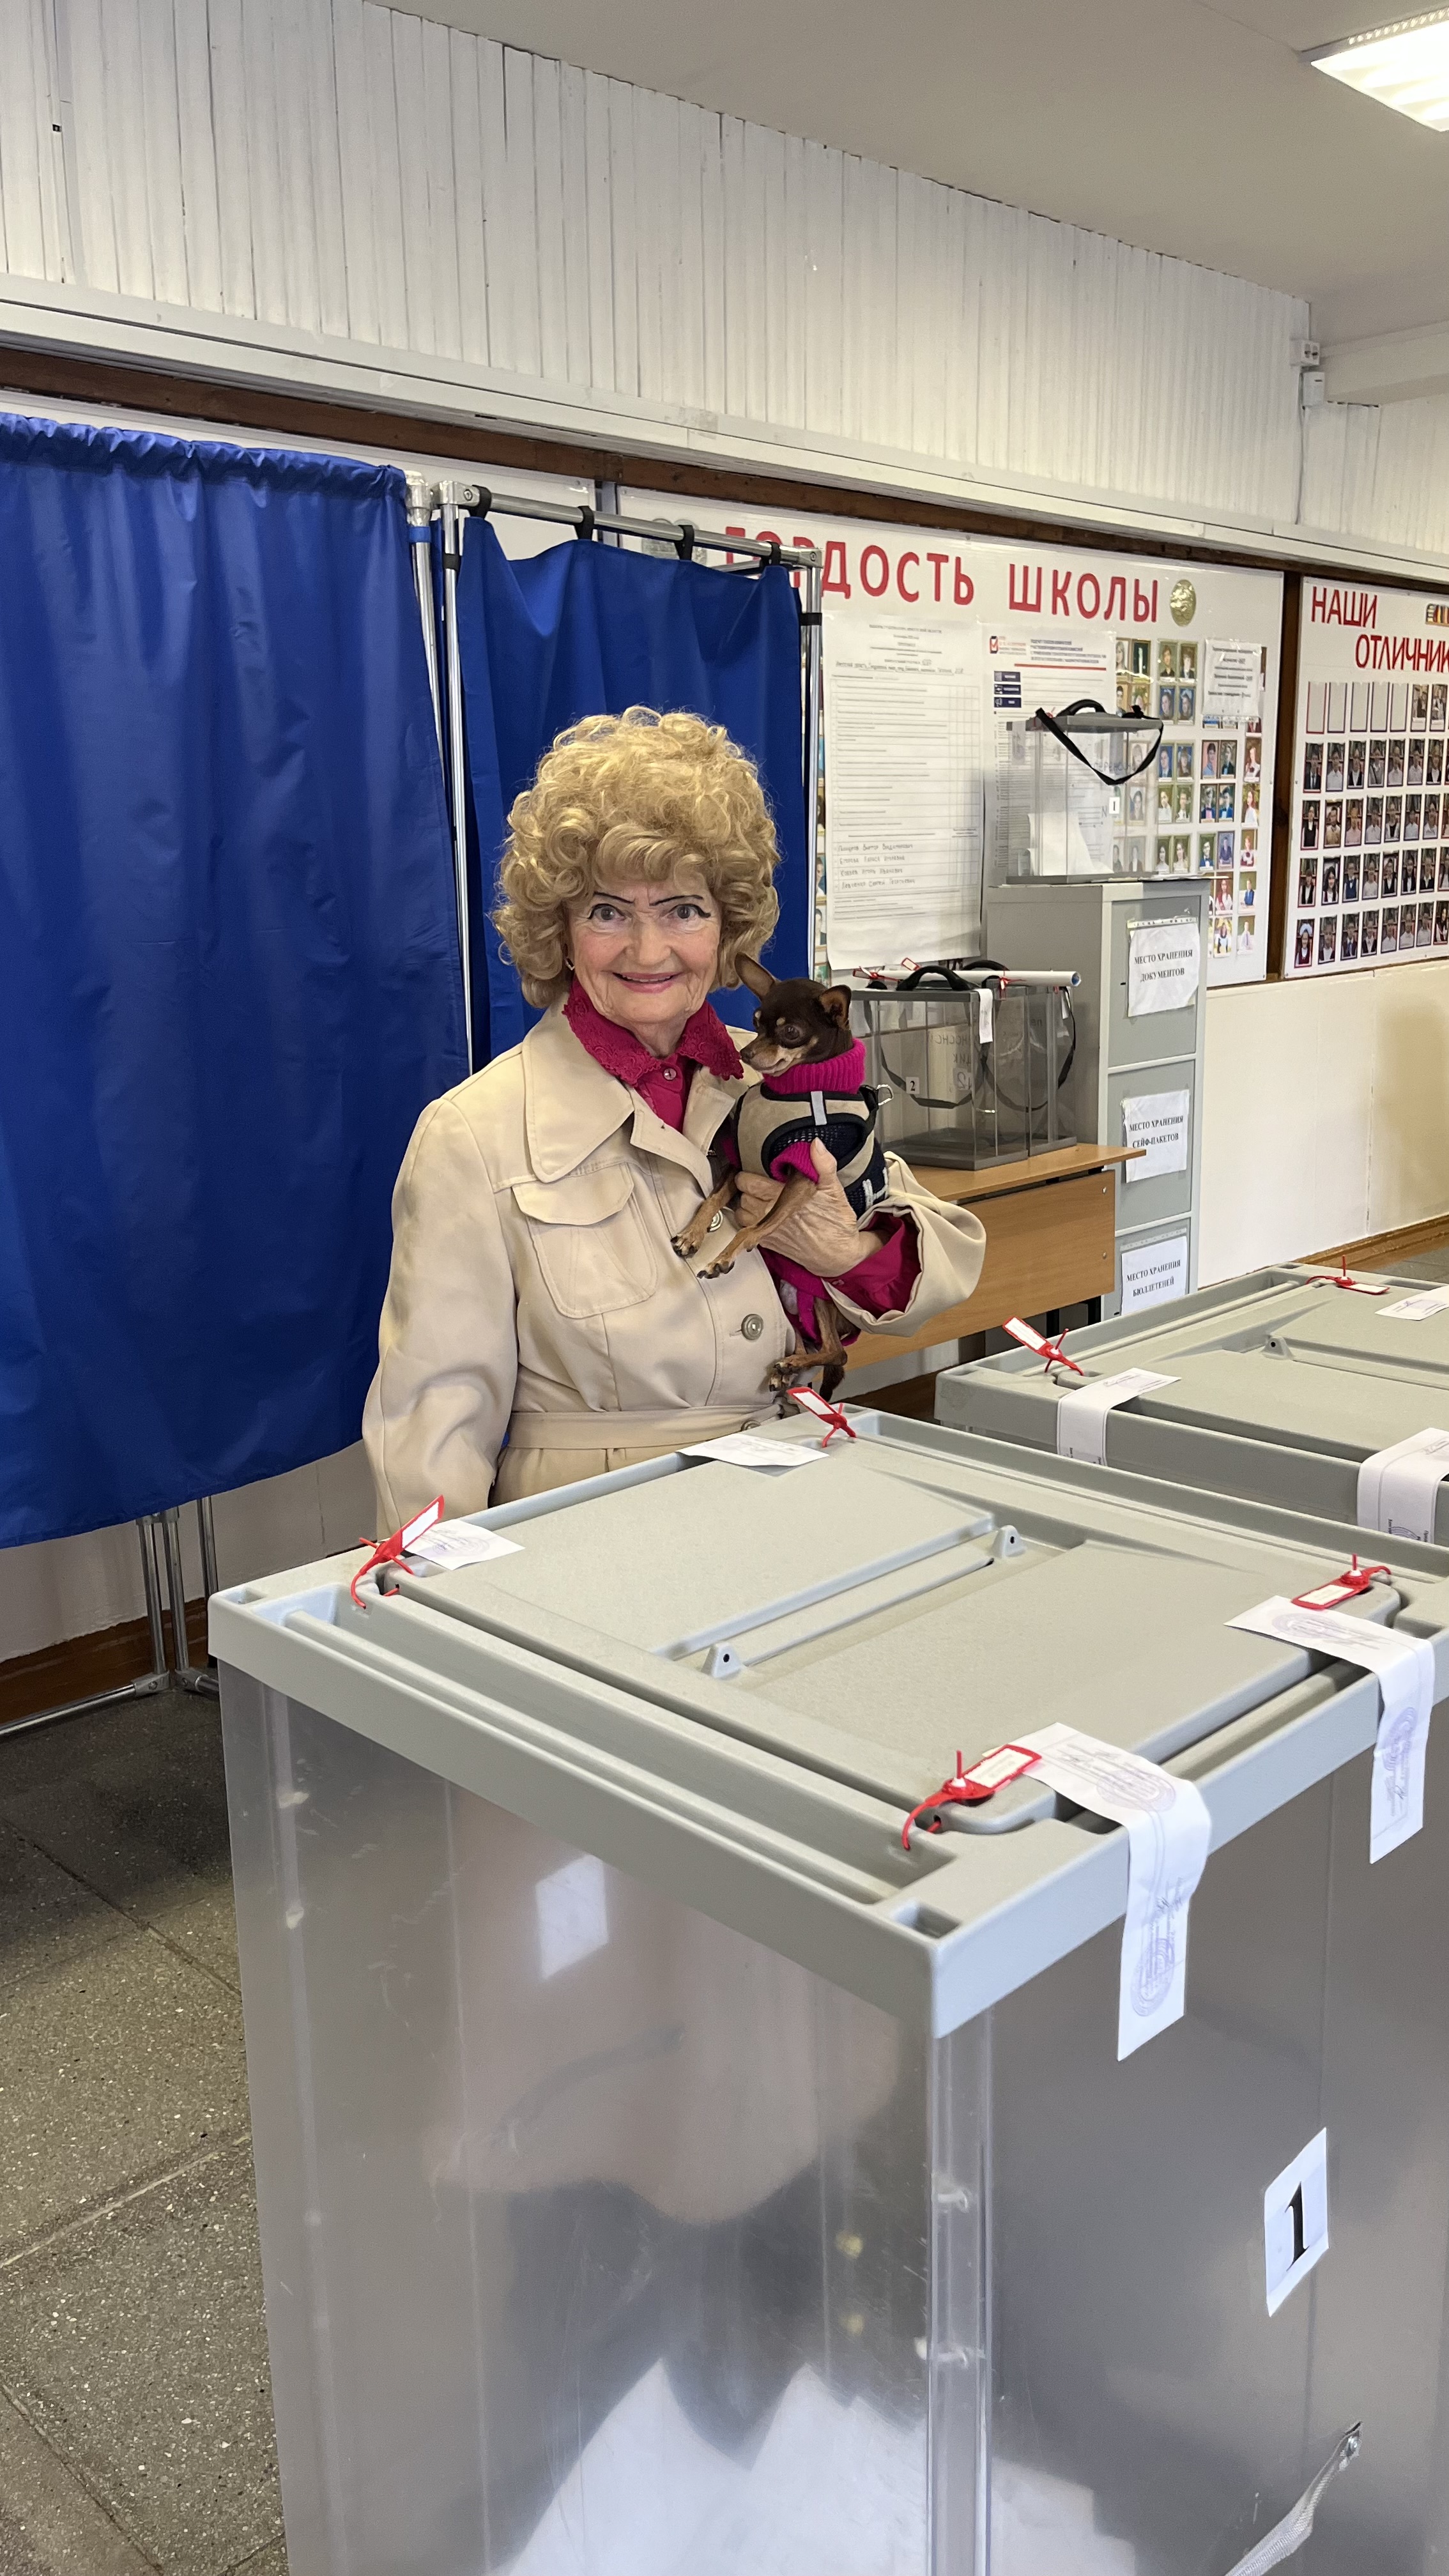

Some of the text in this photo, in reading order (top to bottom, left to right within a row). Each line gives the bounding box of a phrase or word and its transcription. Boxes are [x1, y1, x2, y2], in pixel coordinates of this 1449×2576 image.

[1008, 563, 1158, 623] ШКОЛЫ
[1311, 586, 1377, 629] НАШИ
[1135, 949, 1193, 964] МЕСТО ХРАНЕНИЯ
[1141, 968, 1184, 982] ДОКУМЕНТОВ
[910, 1080, 916, 1092] 2
[1130, 1116, 1183, 1131] МЕСТО ХРАНЕНИЯ
[1132, 1133, 1179, 1148] СЕЙФ-ПАКЕТОВ
[1127, 1260, 1181, 1282] МЕСТО ХРАНЕНИЯ
[1133, 1276, 1174, 1297] БЮЛЛЕТЕНЕЙ
[1284, 2181, 1310, 2272] 1
